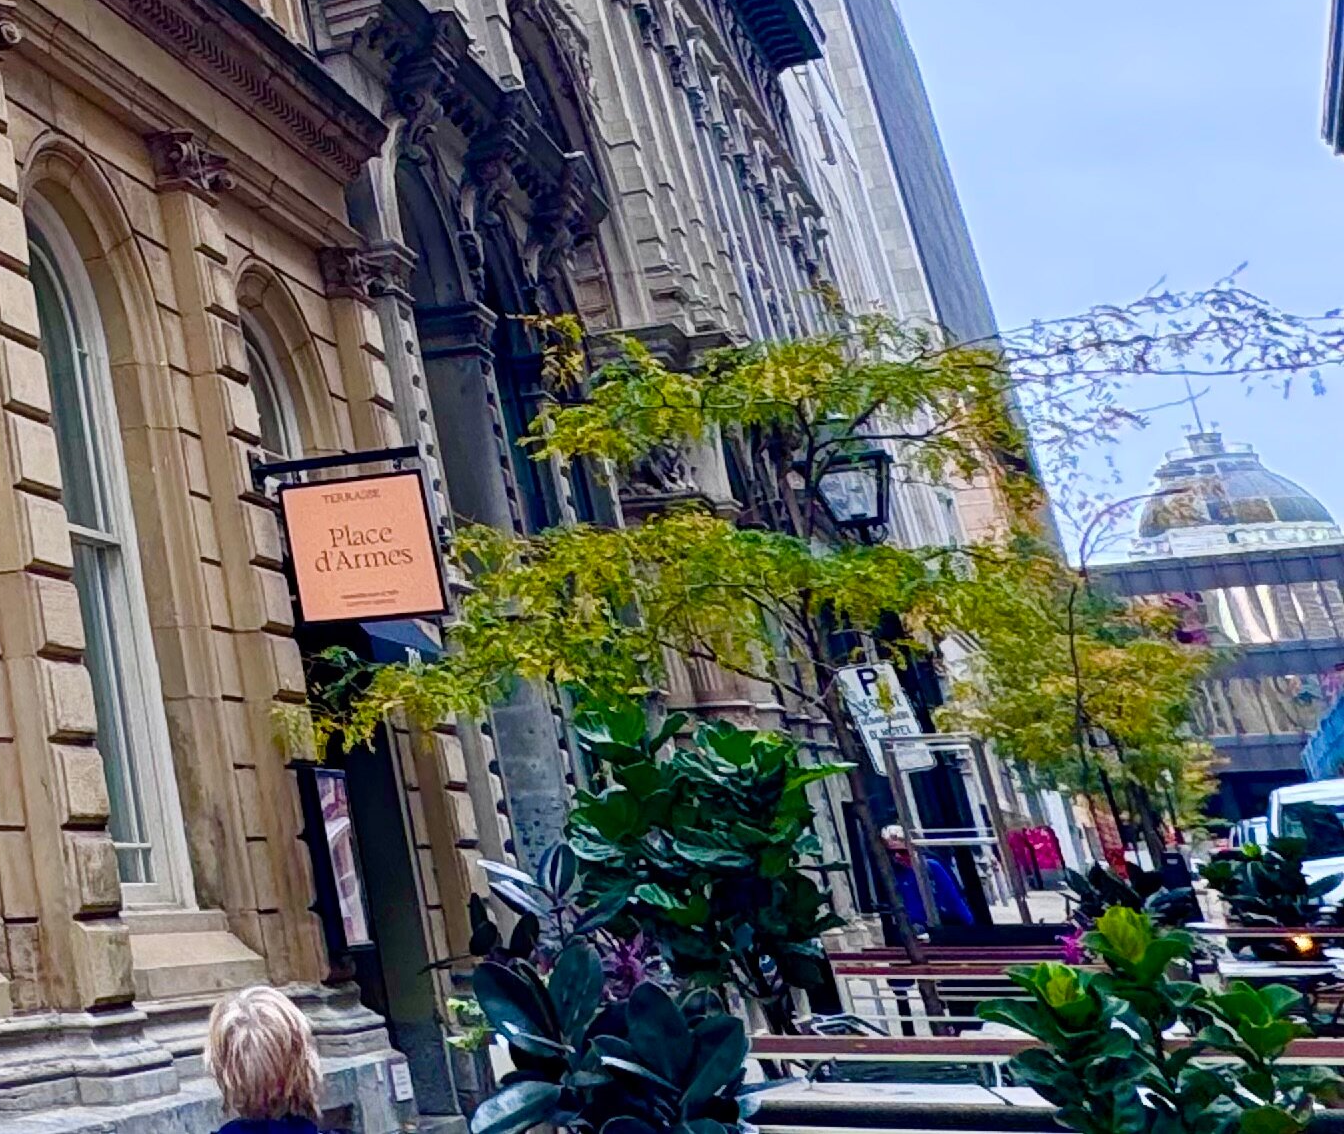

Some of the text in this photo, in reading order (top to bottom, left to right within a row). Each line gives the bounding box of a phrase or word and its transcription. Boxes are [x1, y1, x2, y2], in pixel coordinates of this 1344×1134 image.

[329, 524, 393, 548] Place
[314, 548, 414, 573] d'Armes
[856, 668, 879, 696] P
